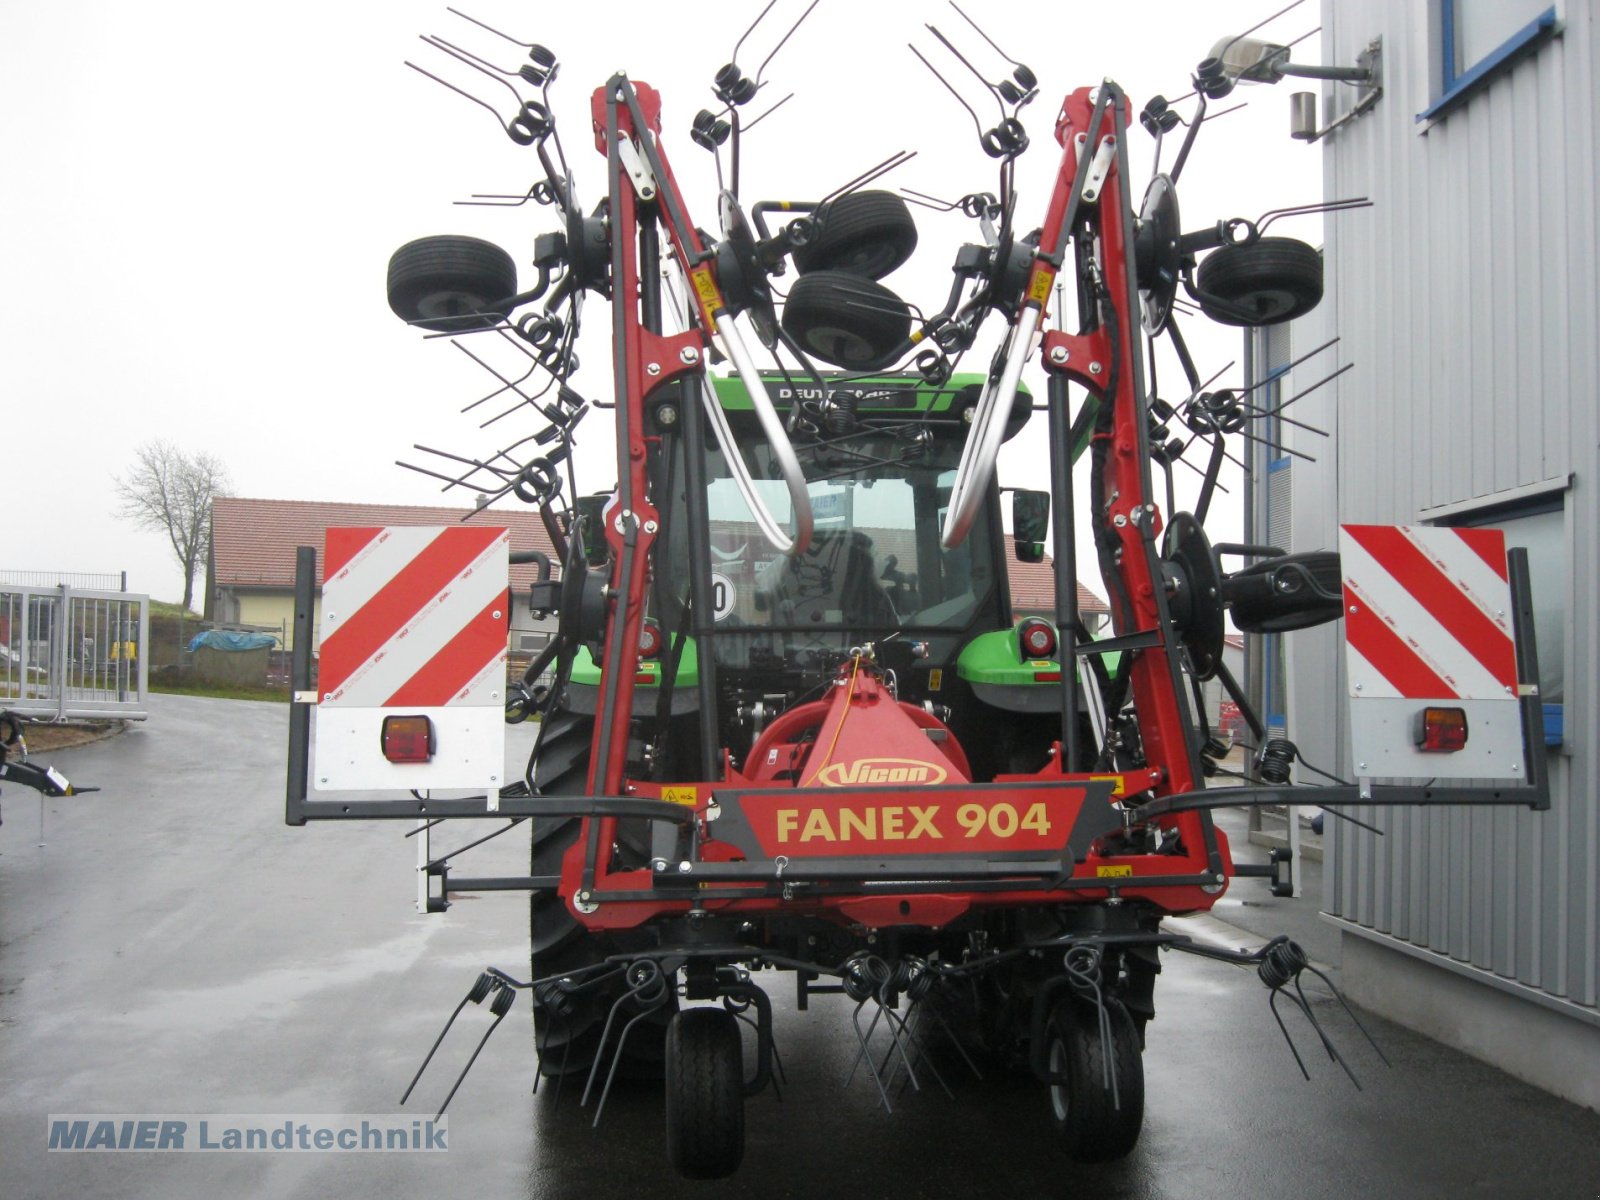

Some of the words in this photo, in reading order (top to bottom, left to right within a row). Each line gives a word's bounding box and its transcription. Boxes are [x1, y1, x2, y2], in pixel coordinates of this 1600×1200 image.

[713, 581, 726, 612] 0
[833, 759, 930, 784] Vicon
[776, 805, 944, 843] FANEX
[956, 802, 1051, 838] 904
